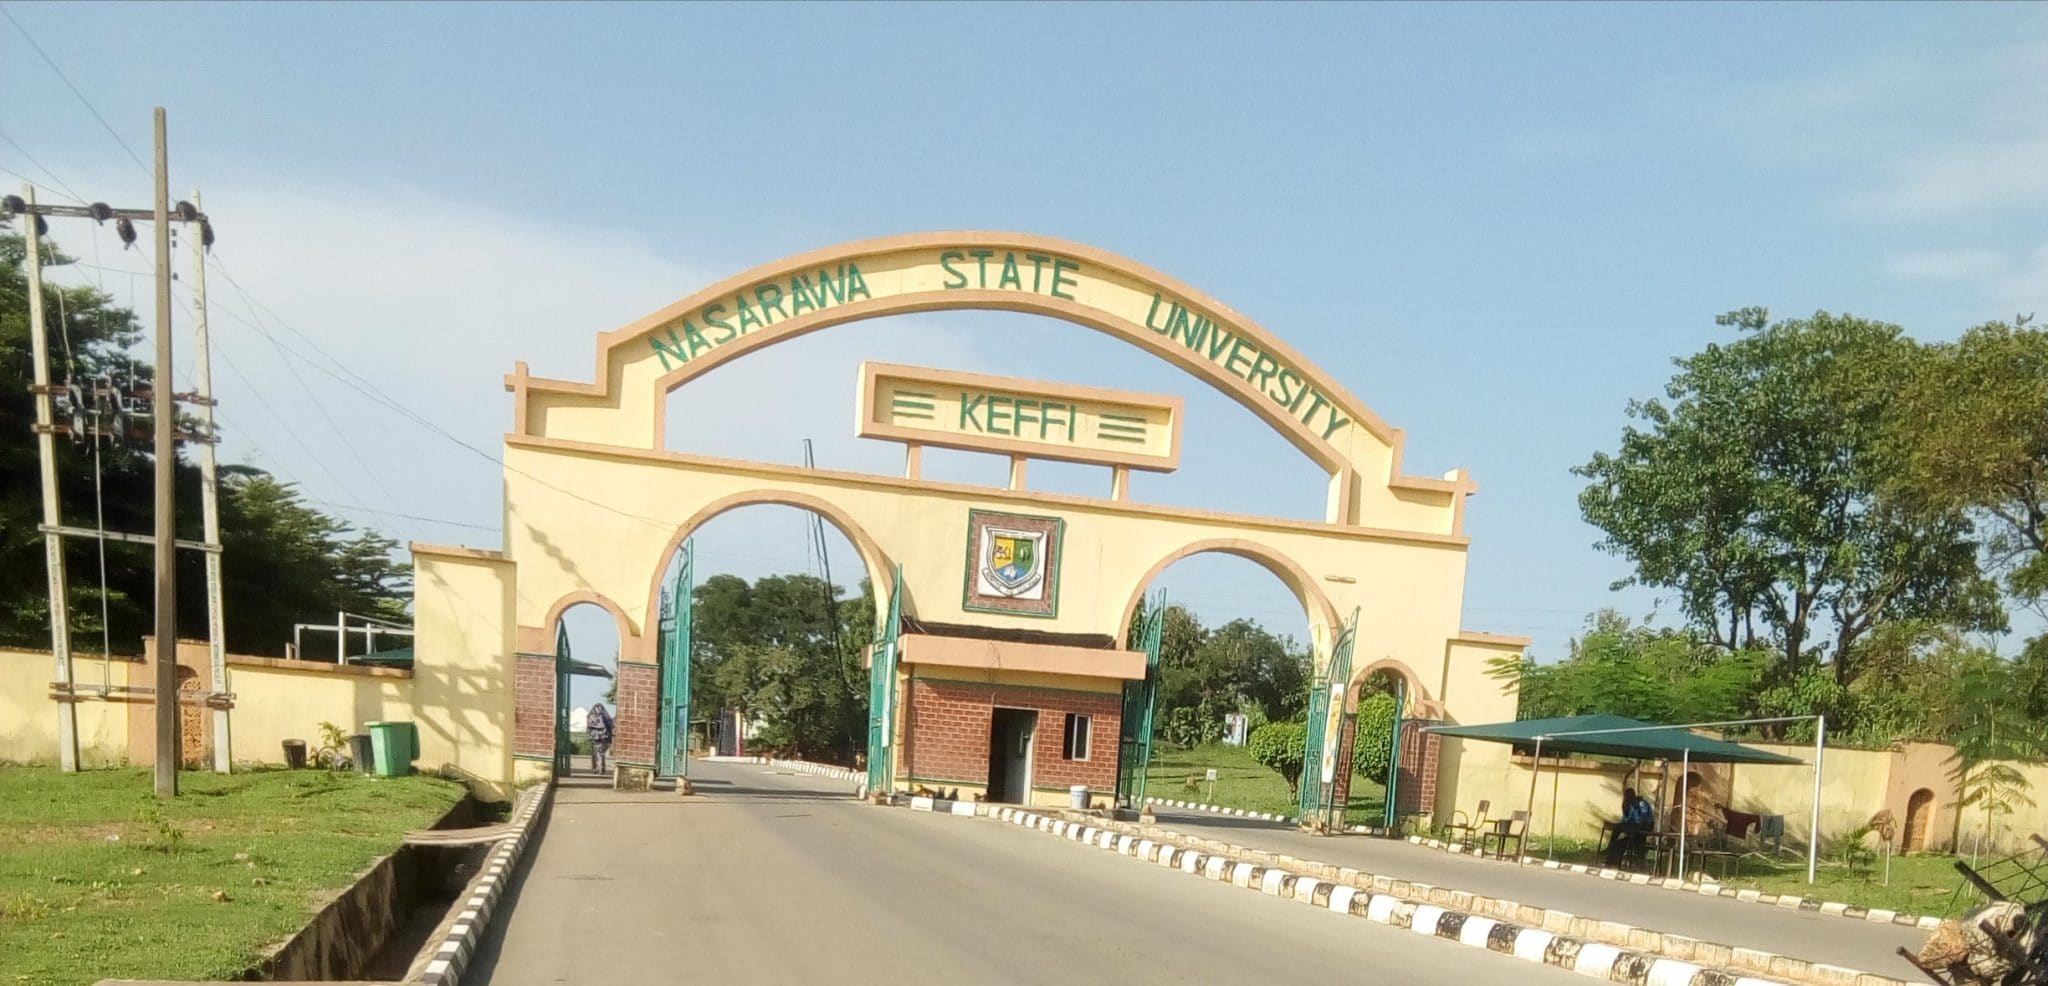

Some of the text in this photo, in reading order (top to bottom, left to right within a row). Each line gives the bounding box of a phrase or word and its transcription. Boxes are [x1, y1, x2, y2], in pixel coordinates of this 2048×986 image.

[650, 250, 1350, 440] NASARAWA STATE UNIVERSITY
[960, 393, 1076, 443] KEFFI
